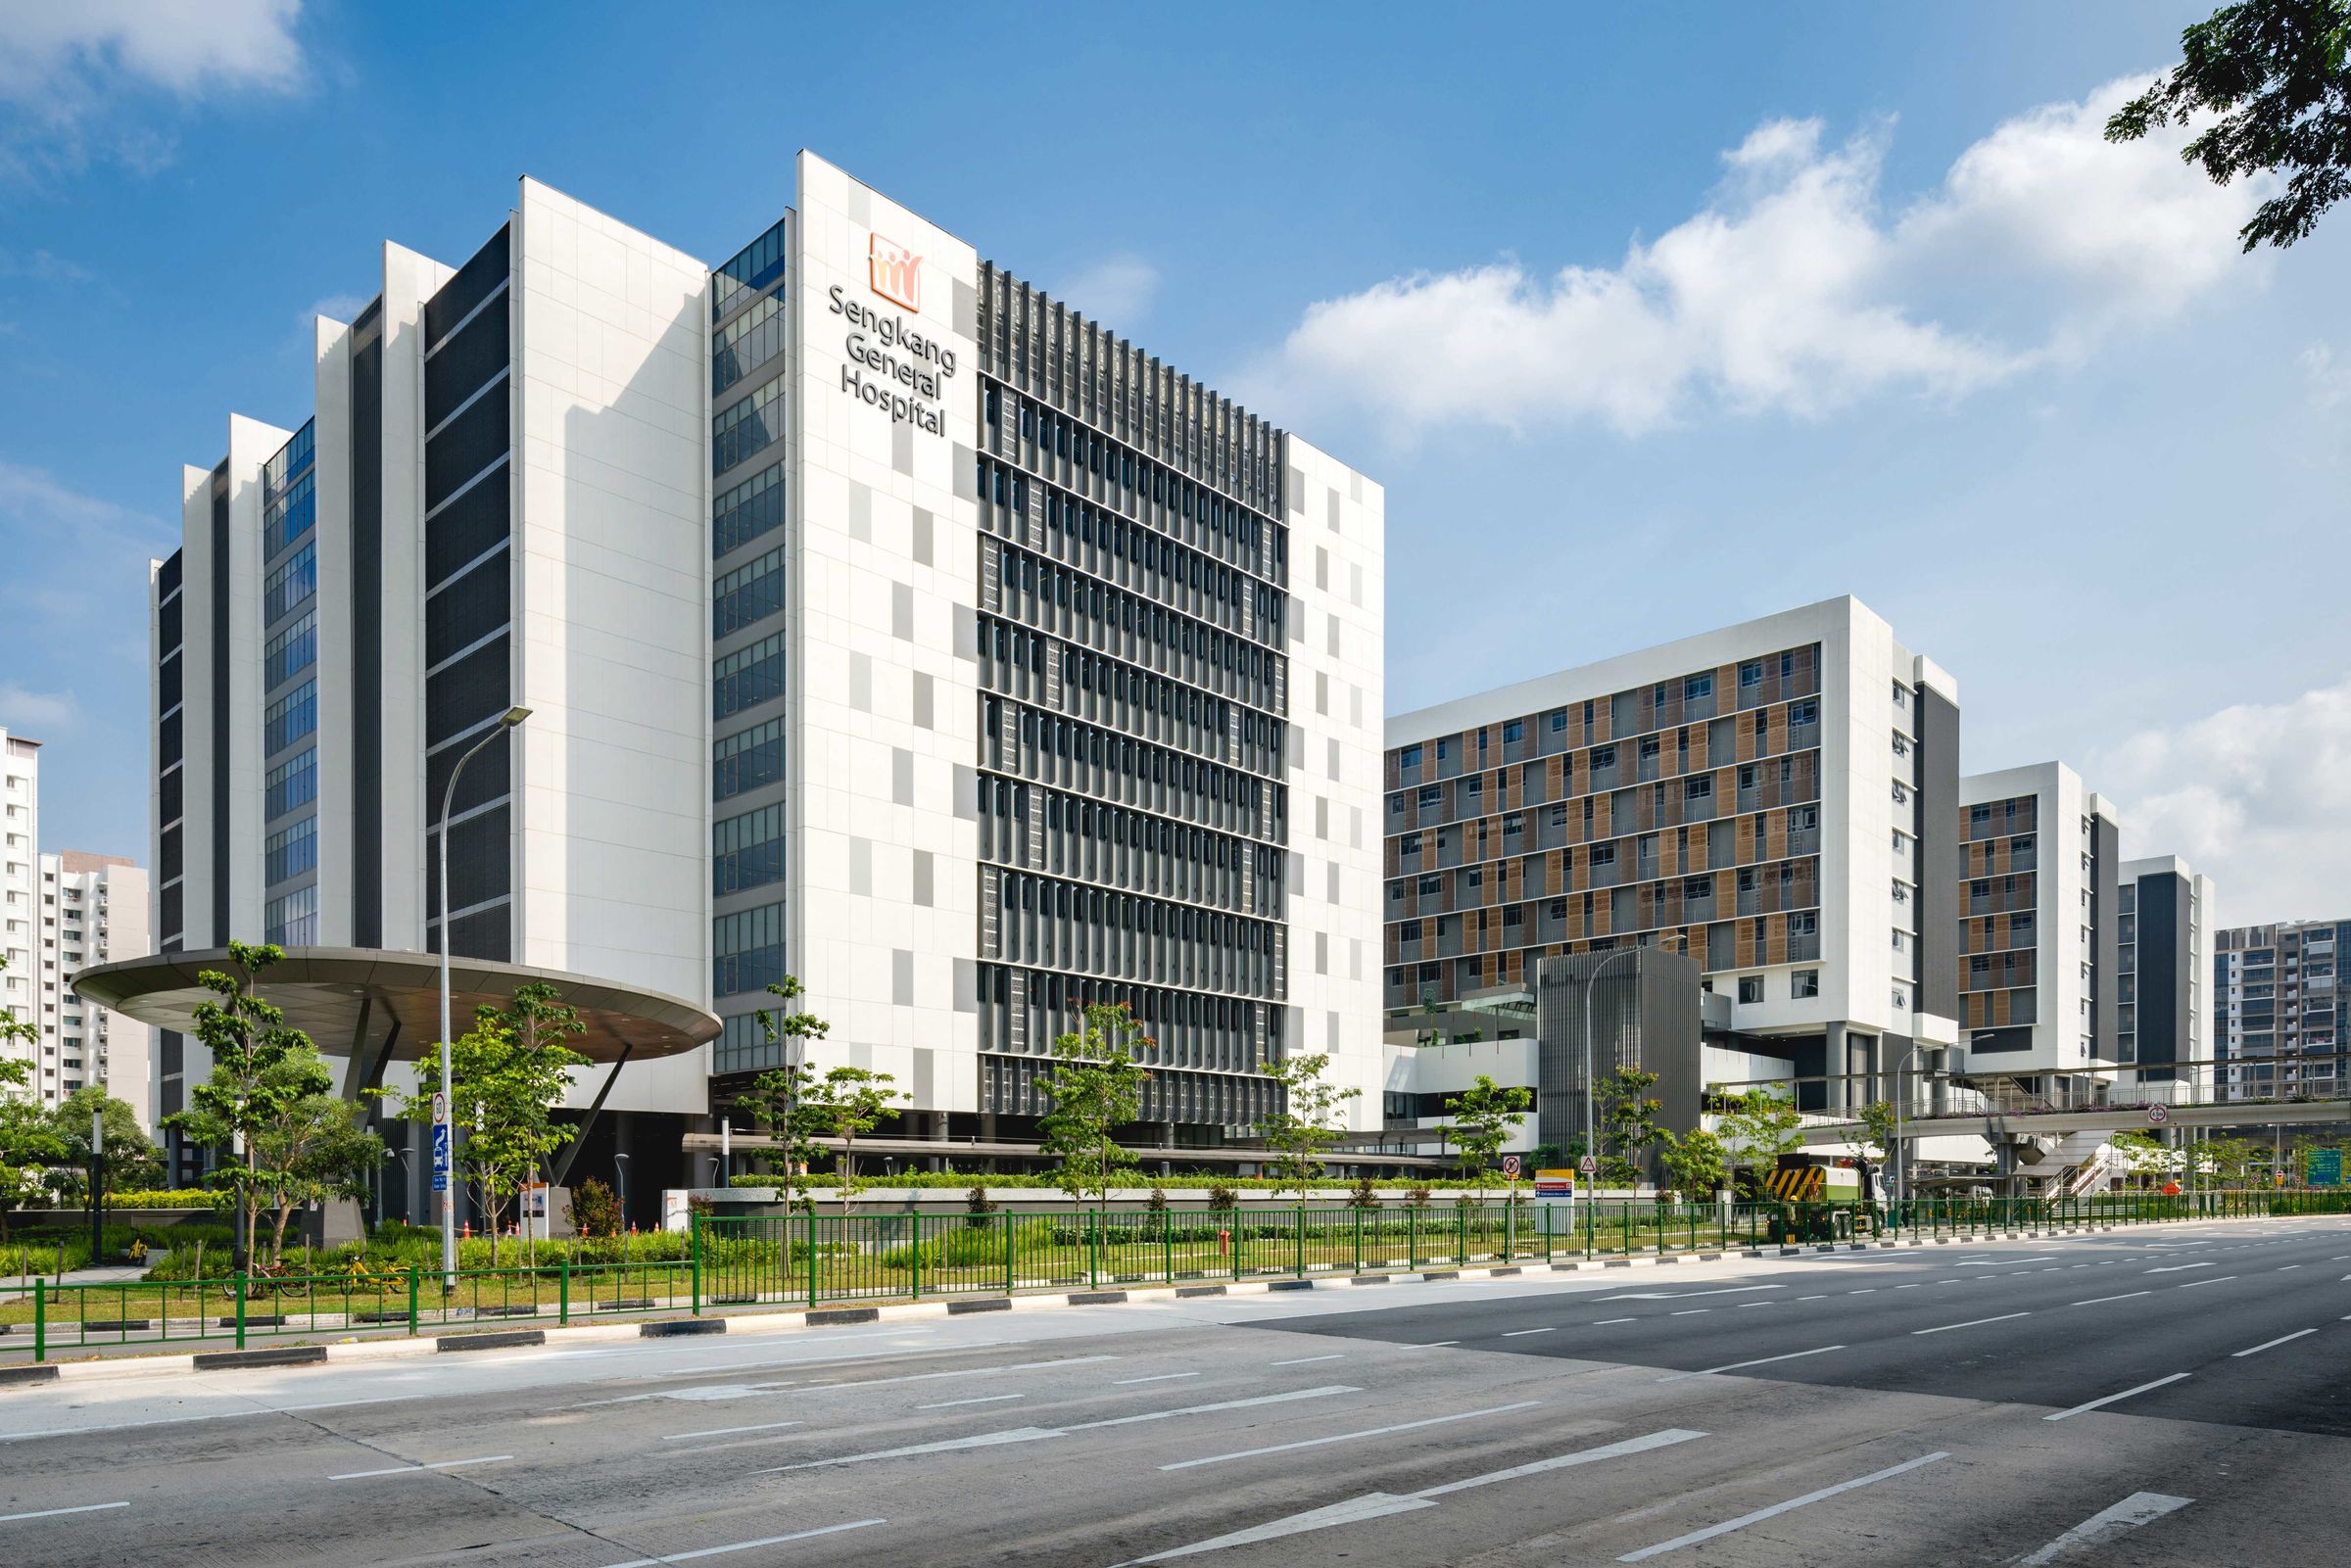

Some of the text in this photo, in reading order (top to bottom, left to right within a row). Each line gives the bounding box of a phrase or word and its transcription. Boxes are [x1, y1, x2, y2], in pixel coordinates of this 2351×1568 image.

[829, 284, 956, 378] Sengkang
[846, 332, 941, 400] General
[841, 363, 945, 437] Hospital
